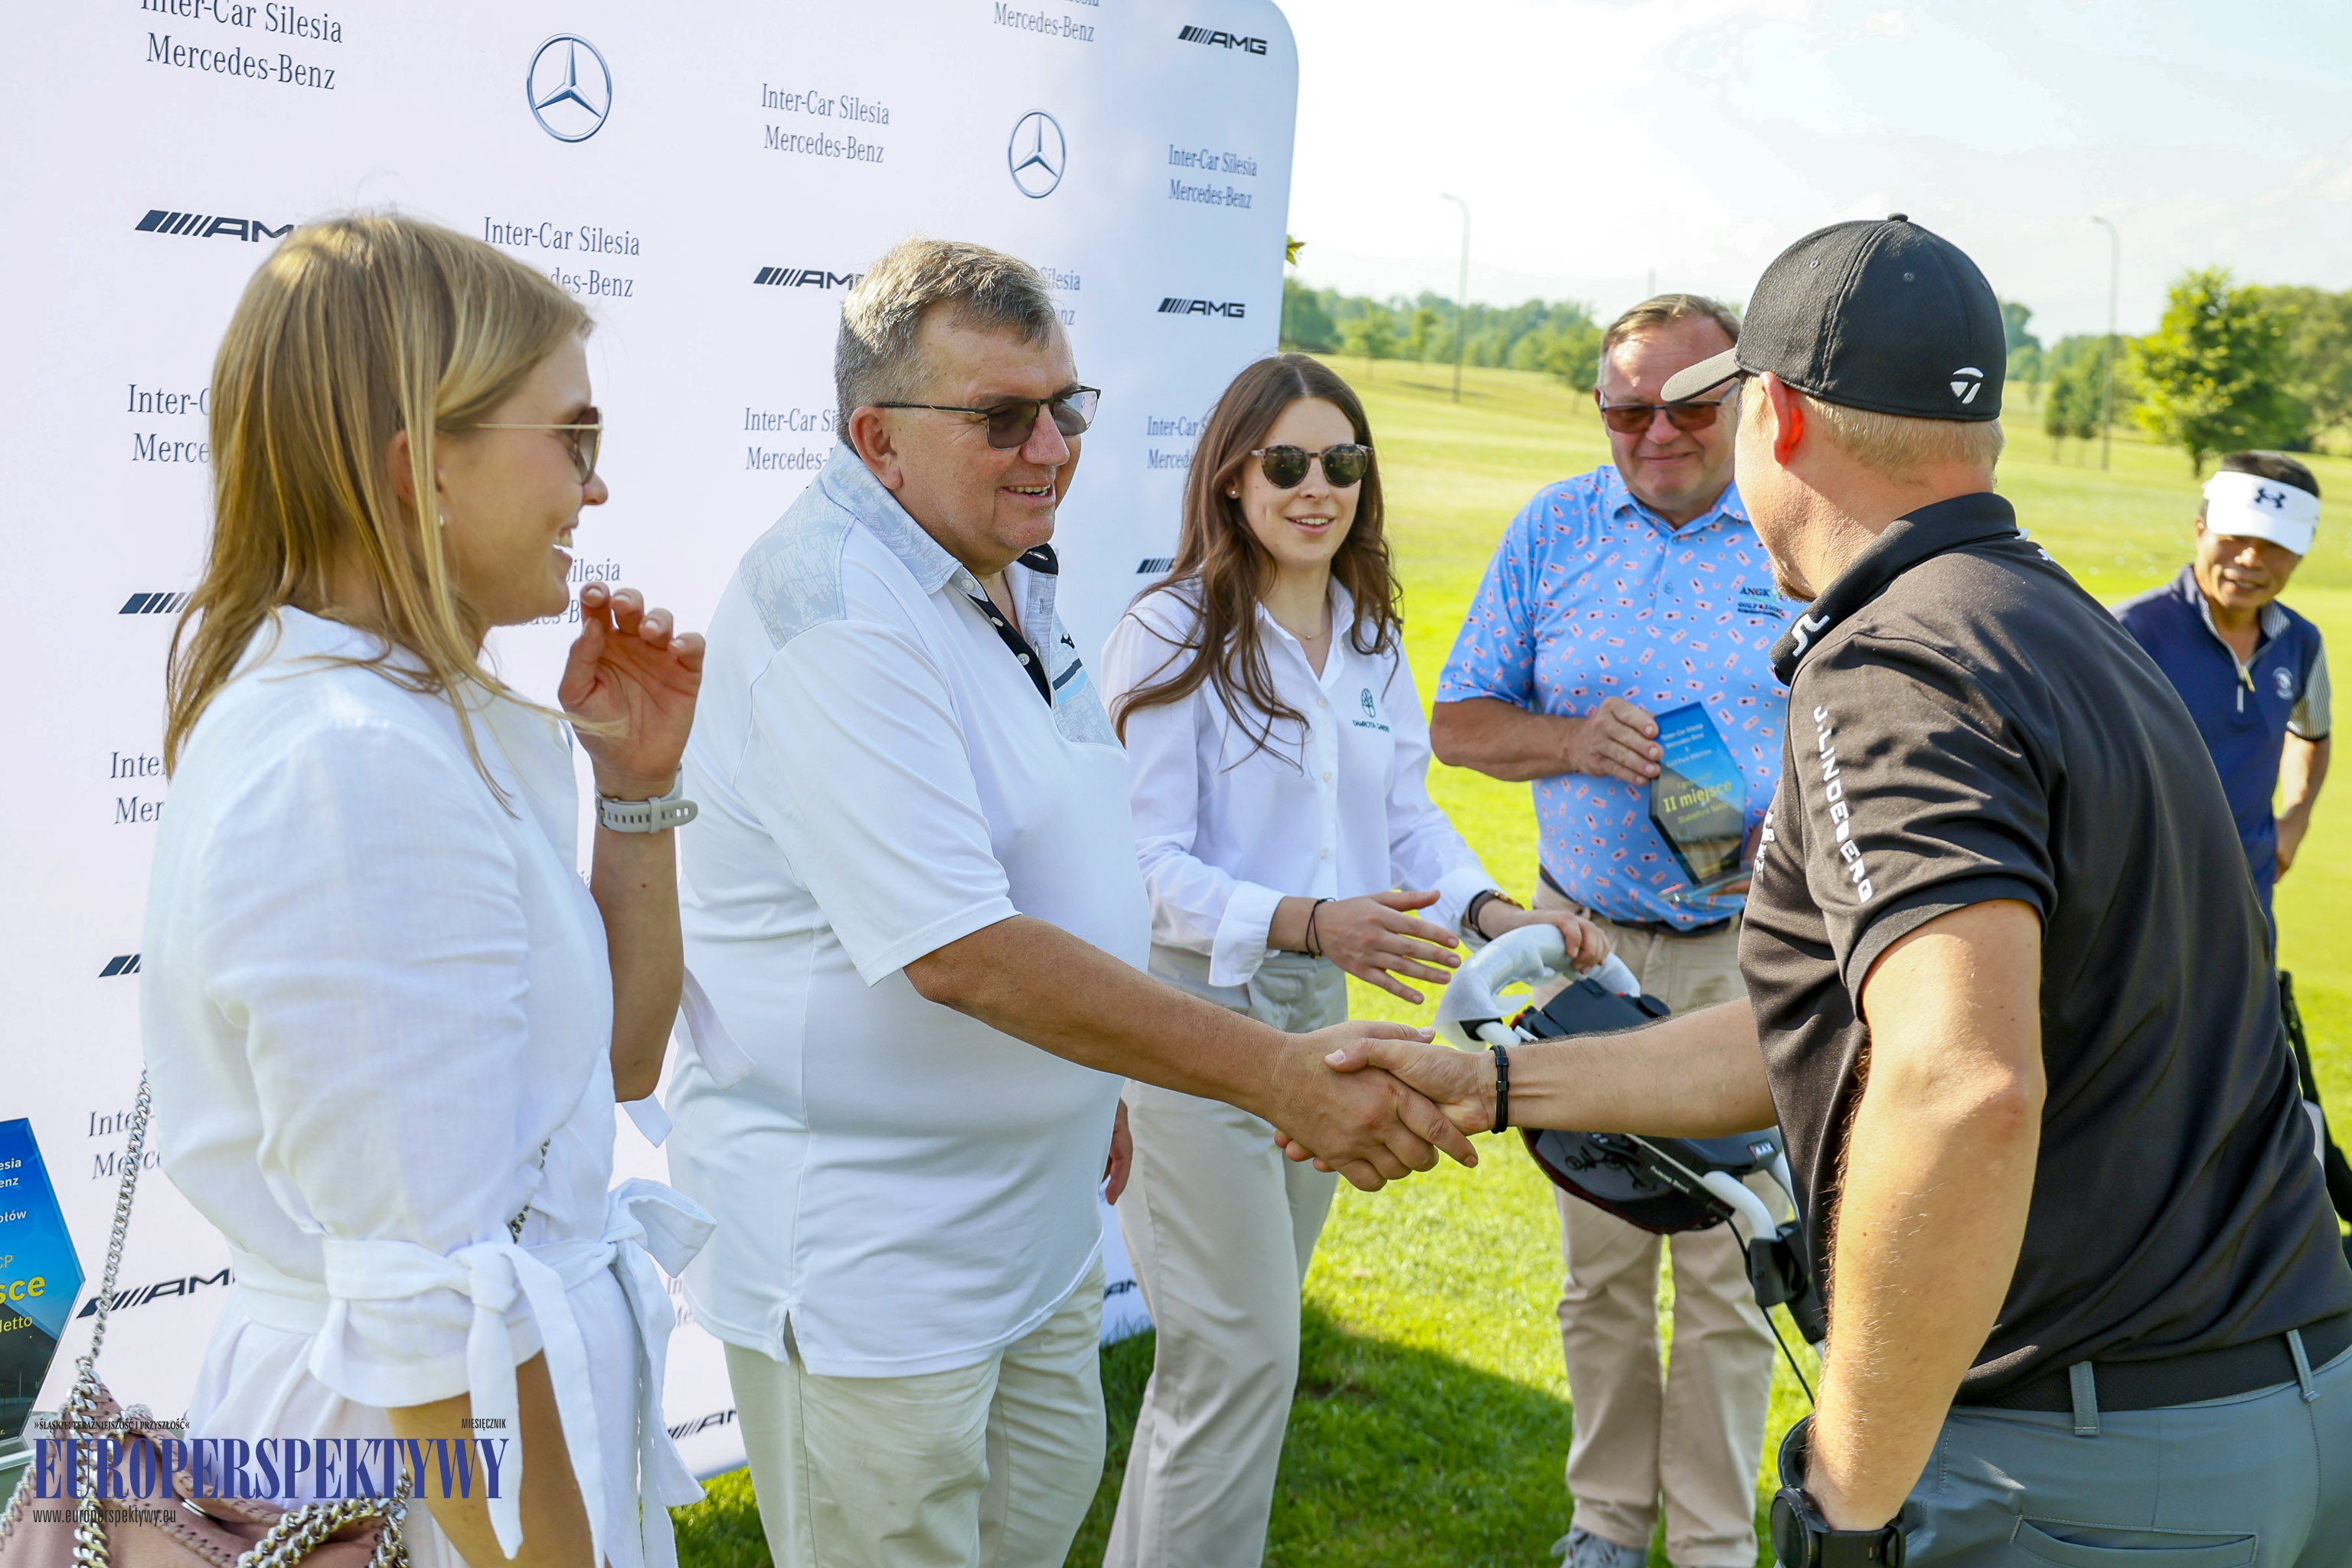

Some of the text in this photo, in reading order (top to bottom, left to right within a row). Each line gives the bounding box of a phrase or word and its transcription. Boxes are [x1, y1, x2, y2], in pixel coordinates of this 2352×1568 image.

[266, 2, 343, 43] Silesia
[994, 2, 1095, 42] Mercedes-Benz
[1207, 30, 1268, 55] AMG
[146, 32, 335, 90] Mercedes-Benz
[761, 83, 890, 125] Inter-Car Silesia
[764, 125, 884, 163] Mercedes-Benz
[1168, 144, 1257, 176] Inter-Car Silesia
[1168, 178, 1253, 209] Mercedes-Benz
[485, 217, 640, 256] Inter-Car Silesia
[1186, 299, 1245, 318] AMG
[127, 384, 211, 416] Inter-C
[744, 407, 817, 432] Inter-Car
[1147, 415, 1197, 436] Inter-Car
[746, 446, 831, 470] Mercedes-
[567, 558, 621, 583] ilesia
[1663, 796, 1677, 813] II
[1679, 780, 1732, 808] miejsce
[0, 1158, 22, 1171] esia
[141, 1268, 230, 1305] AM
[0, 1316, 33, 1332] etto
